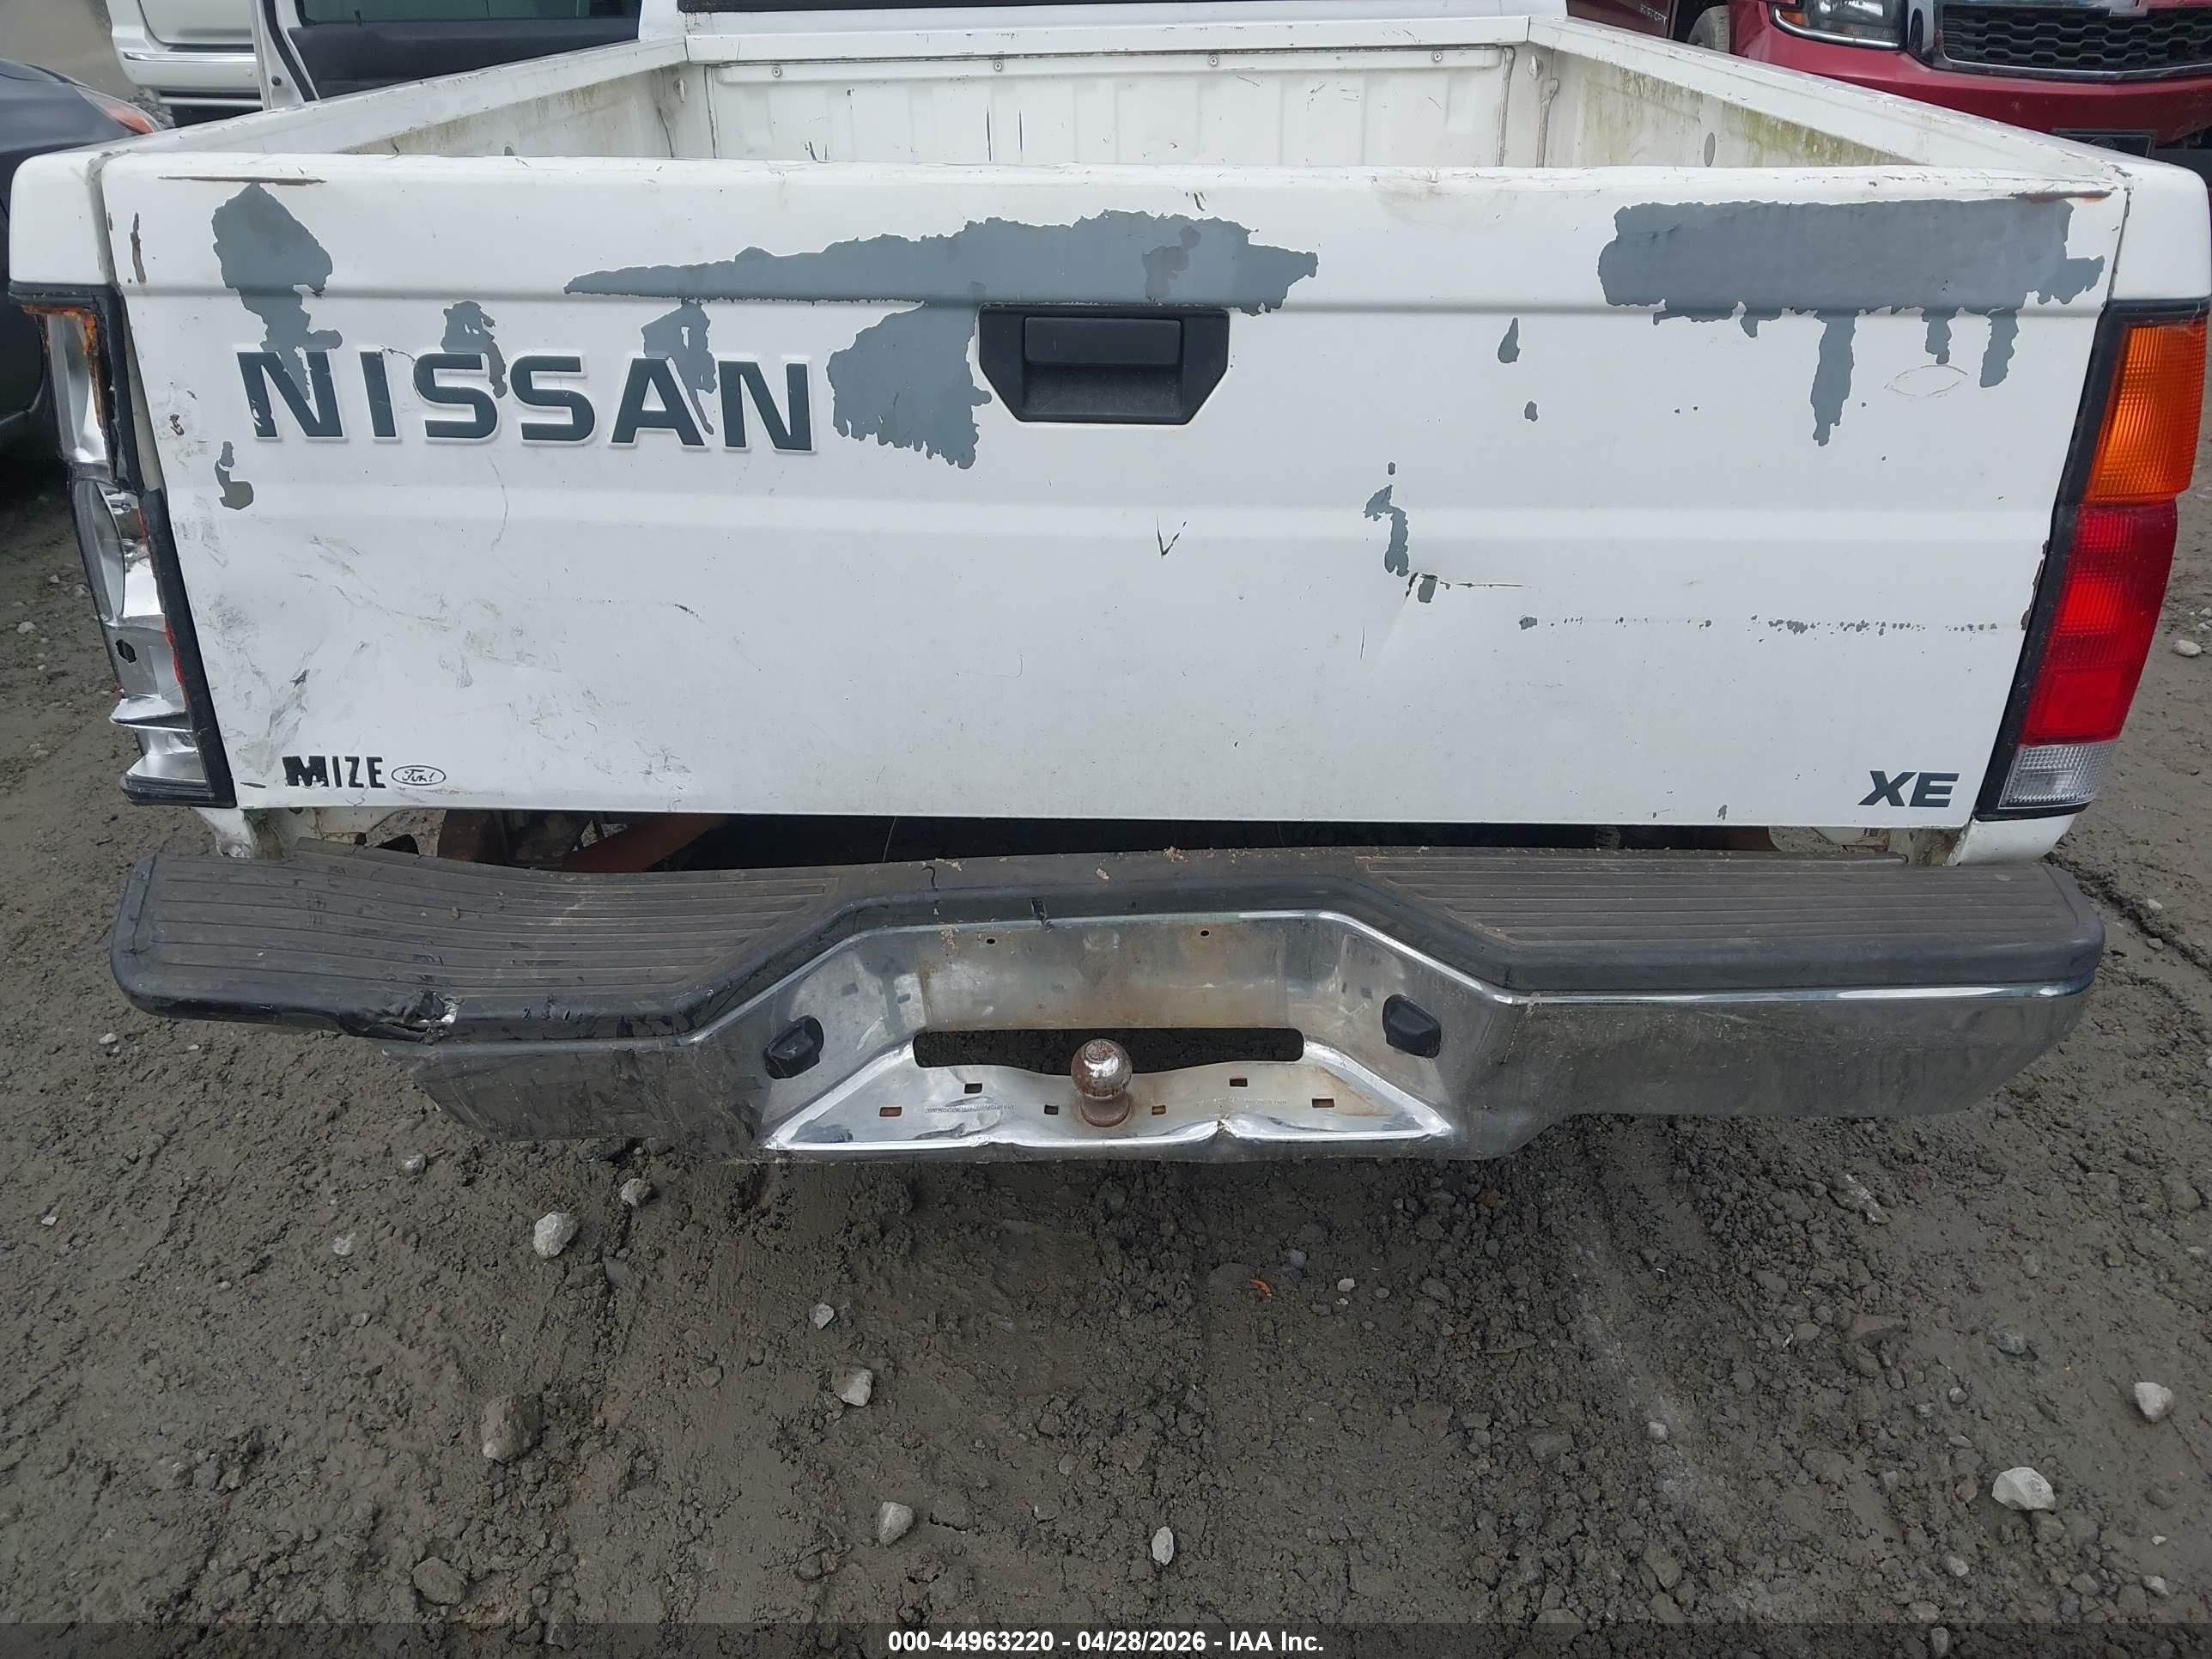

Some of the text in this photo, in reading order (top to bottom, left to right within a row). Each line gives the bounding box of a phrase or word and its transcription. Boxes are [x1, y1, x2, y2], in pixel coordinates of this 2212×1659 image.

[237, 350, 814, 453] NISSAN
[282, 755, 386, 788] MIZE
[1857, 770, 1960, 808] XE
